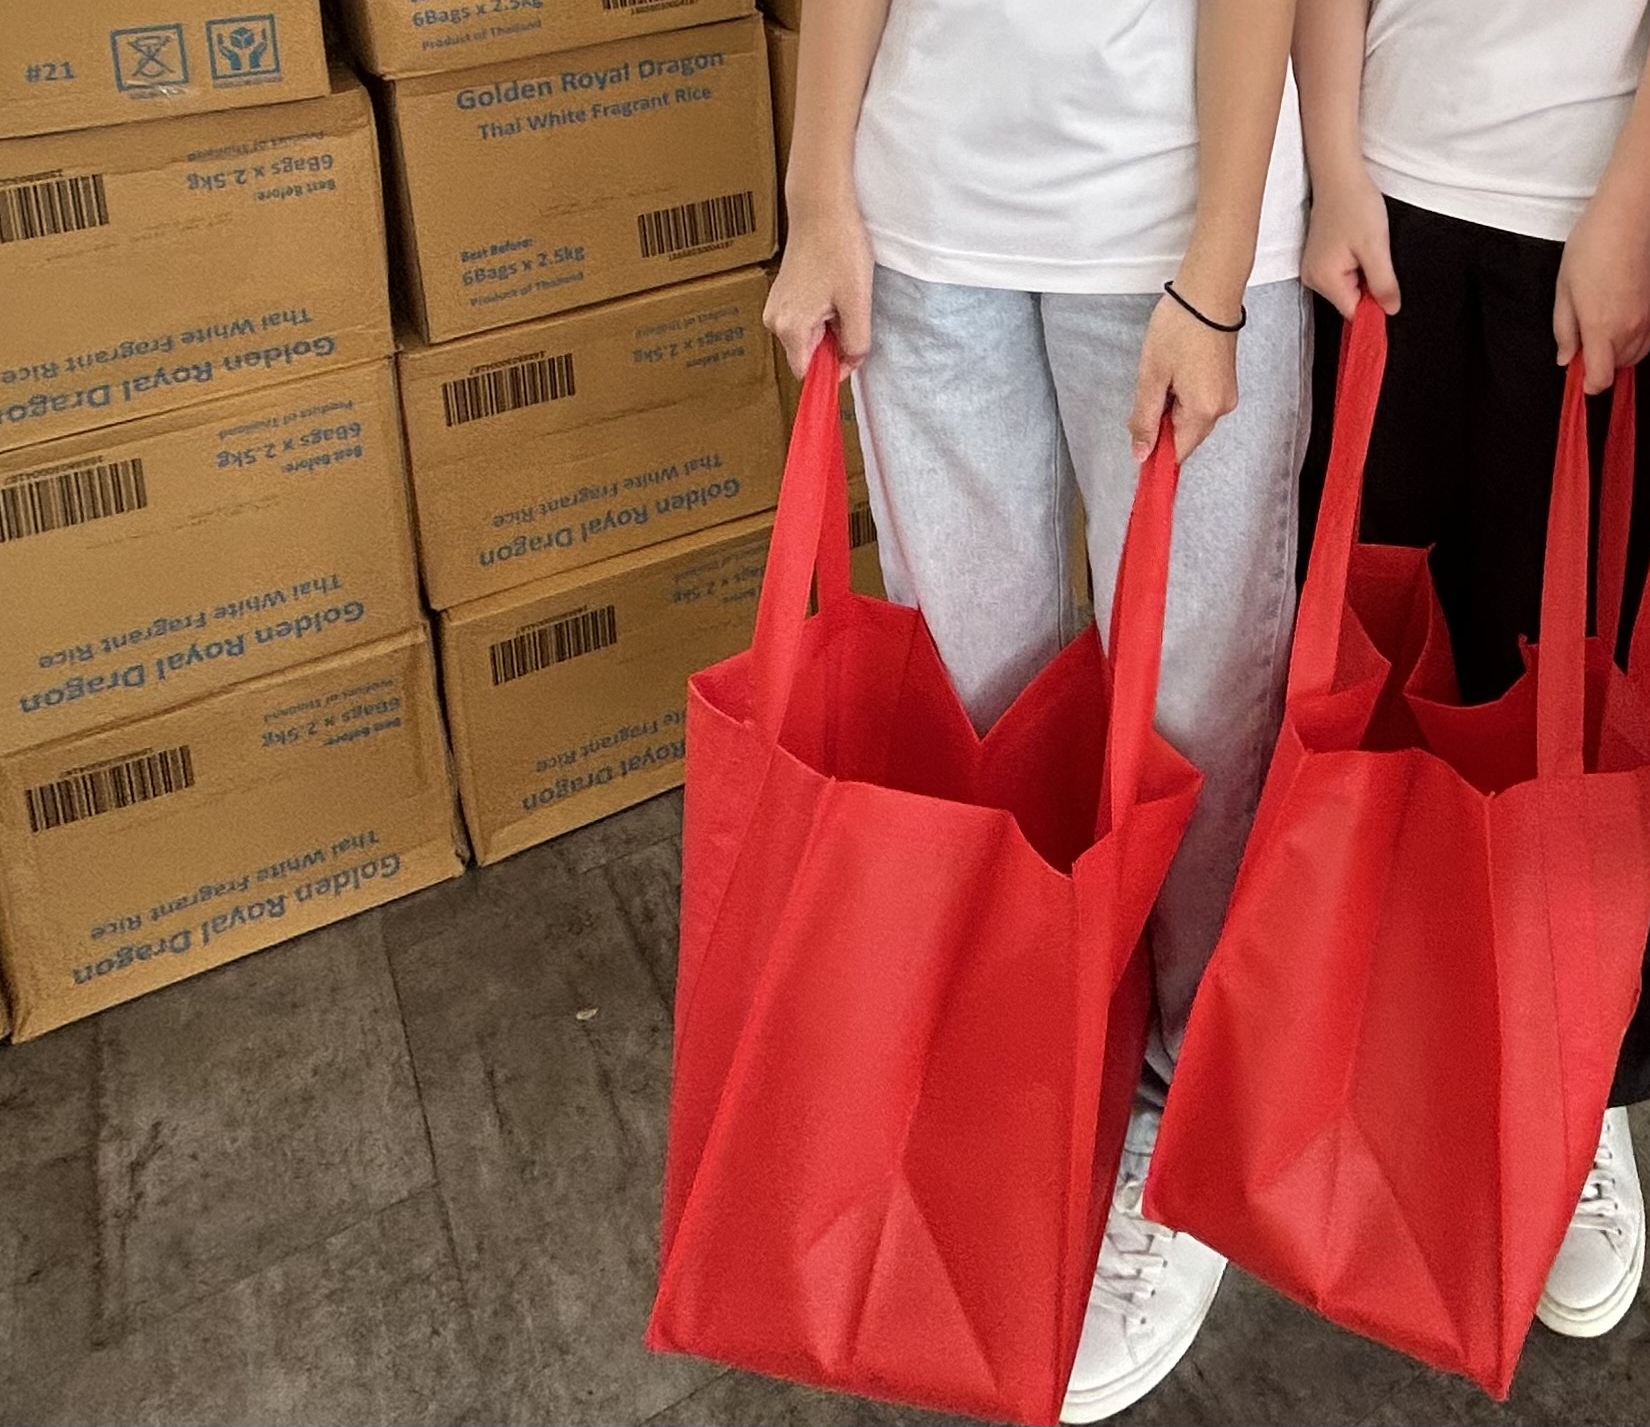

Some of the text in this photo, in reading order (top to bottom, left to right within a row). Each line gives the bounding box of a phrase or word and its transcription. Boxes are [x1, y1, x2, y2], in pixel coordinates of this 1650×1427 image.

[412, 7, 471, 27] 6Bags
[25, 61, 75, 83] #21
[456, 49, 725, 111] Golden Royal Dragon
[478, 86, 713, 141] Thai White Fragrant Rice
[271, 152, 334, 175] 6Bags
[462, 263, 519, 286] 6Bags
[537, 245, 586, 268] 2.5kg
[1, 308, 312, 385] Thai White Fragrant Rice
[0, 336, 336, 425] Golden Royal Drago
[216, 442, 277, 468] 2.5kg
[299, 421, 362, 447] 6Bags
[492, 454, 723, 528] Thai White Fragrant Rice
[478, 477, 742, 568] Golden Royal Dragon
[38, 574, 344, 669] Thai White Fragrant Rice
[20, 602, 366, 714] Golden Royal Dragon
[536, 750, 577, 773] Rice
[580, 720, 659, 759] Fragrant
[521, 741, 685, 812] Royal Dragon
[91, 830, 380, 940] Thai White Fragrant Rice
[71, 852, 402, 985] Golden Royal Dragon
